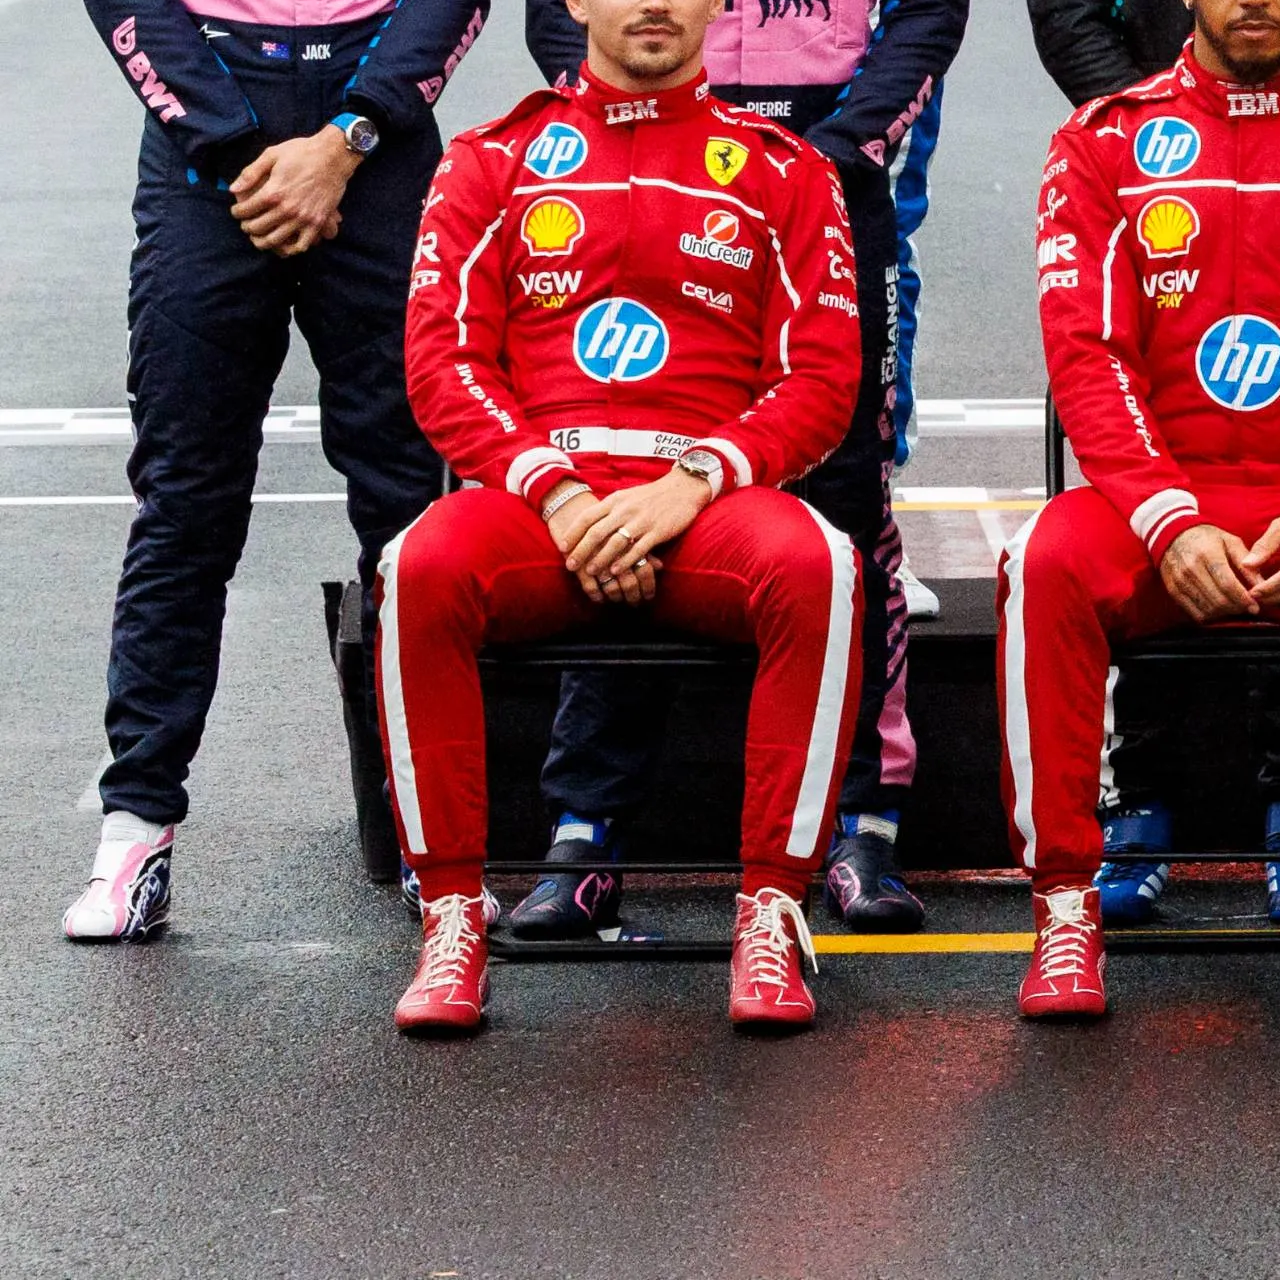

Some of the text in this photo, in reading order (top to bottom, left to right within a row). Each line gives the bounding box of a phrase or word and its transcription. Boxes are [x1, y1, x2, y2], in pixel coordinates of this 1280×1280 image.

[302, 44, 331, 61] JACK
[125, 55, 187, 124] BWT
[605, 99, 659, 124] IBM
[746, 101, 792, 117] PIERRE
[1227, 92, 1280, 117] IBM
[524, 126, 583, 178] hp
[1137, 117, 1199, 177] hp
[680, 234, 754, 270] UniCredit
[517, 270, 583, 295] VGW
[584, 299, 665, 382] hp
[554, 429, 581, 450] 16
